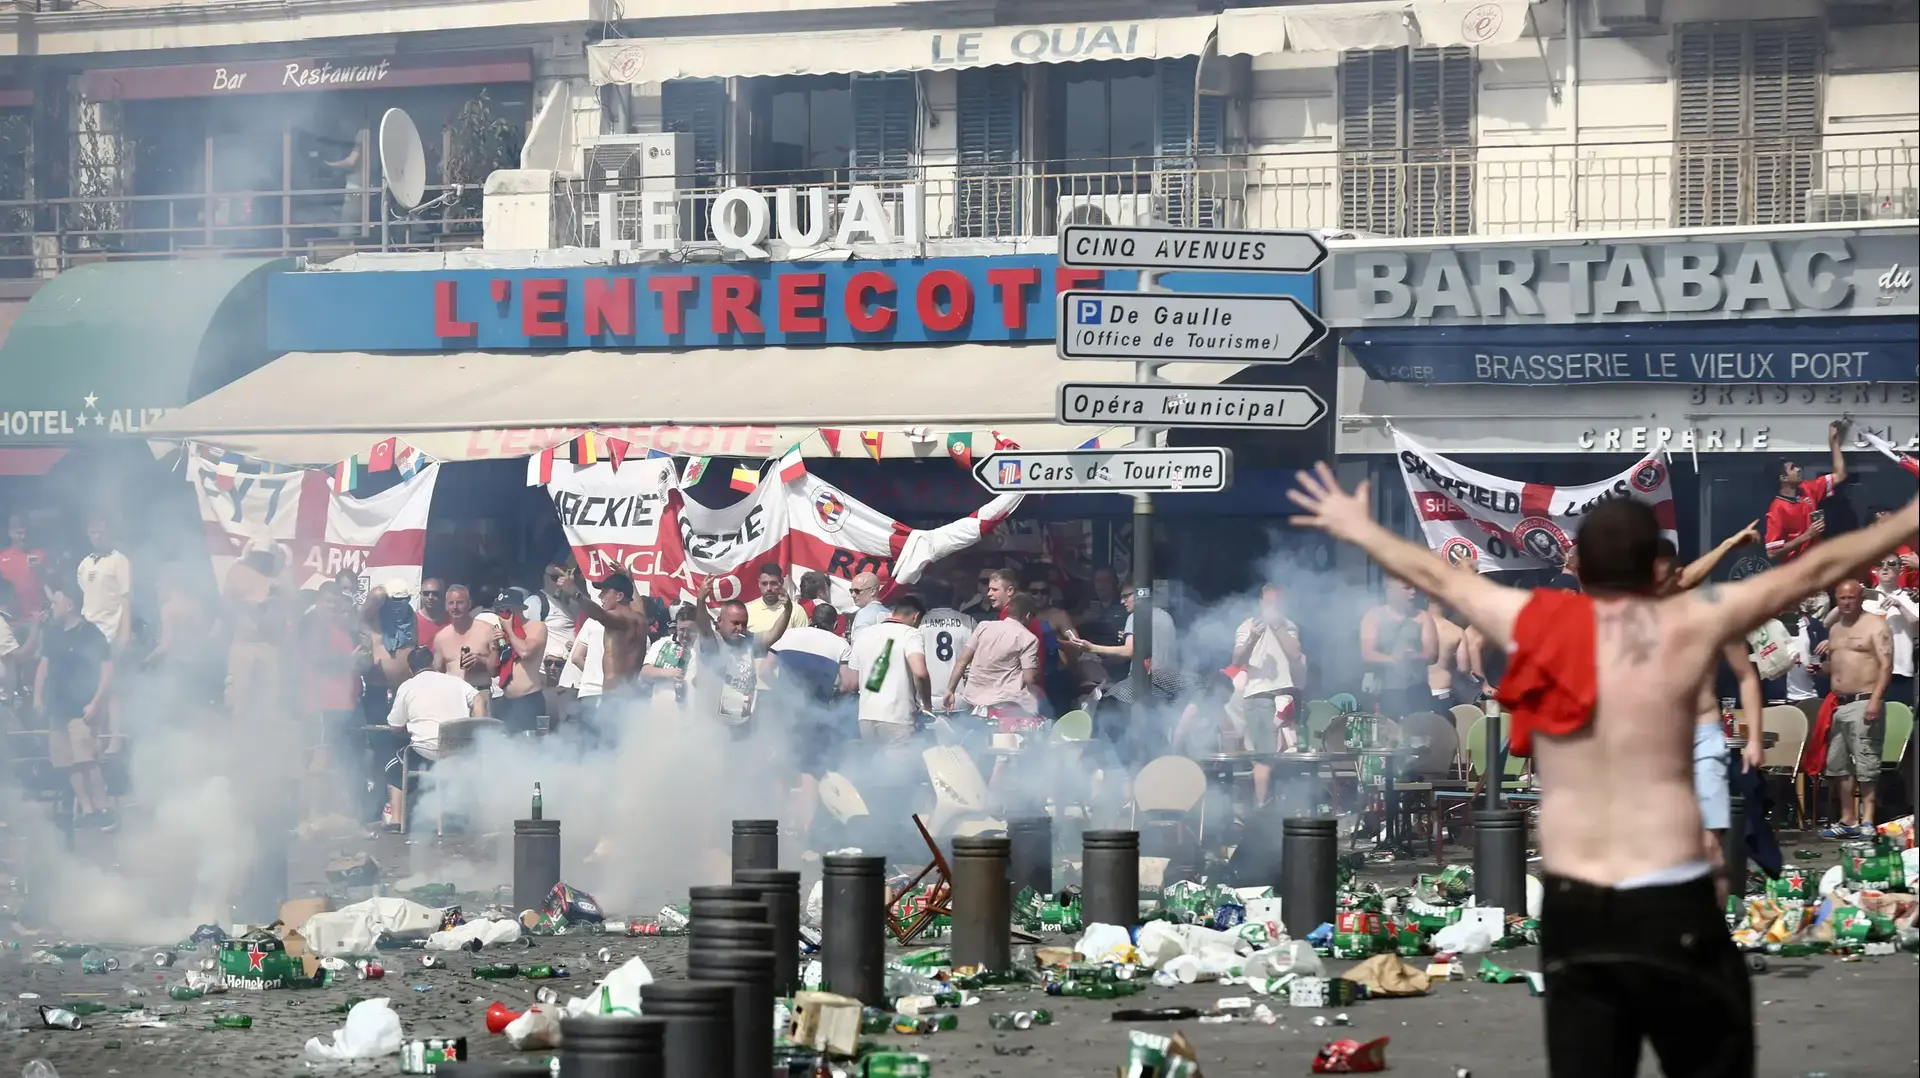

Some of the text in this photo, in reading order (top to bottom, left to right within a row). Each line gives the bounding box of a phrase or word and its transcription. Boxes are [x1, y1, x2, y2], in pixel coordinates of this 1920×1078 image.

[931, 24, 1139, 65] LE QUAI
[213, 58, 390, 90] Bar Restaurant
[598, 184, 926, 259] LE QUAI
[1076, 237, 1266, 261] CINQ AVENUES
[1878, 263, 1913, 289] du
[1110, 305, 1139, 324] De
[1154, 306, 1232, 326] Gaulle
[1076, 330, 1280, 351] (Office de Tourisme)
[1475, 351, 1869, 380] BRASSERIE LE VIEUX PORT
[1074, 394, 1285, 421] Opéra Municipal
[109, 408, 181, 433] ALIZ
[1578, 426, 1770, 450] CREPERIE
[1028, 461, 1074, 481] Cars
[588, 548, 742, 603] ENGLAD
[925, 618, 961, 628] LAMPARD
[936, 631, 953, 661] 8
[226, 973, 283, 990] Heineken
